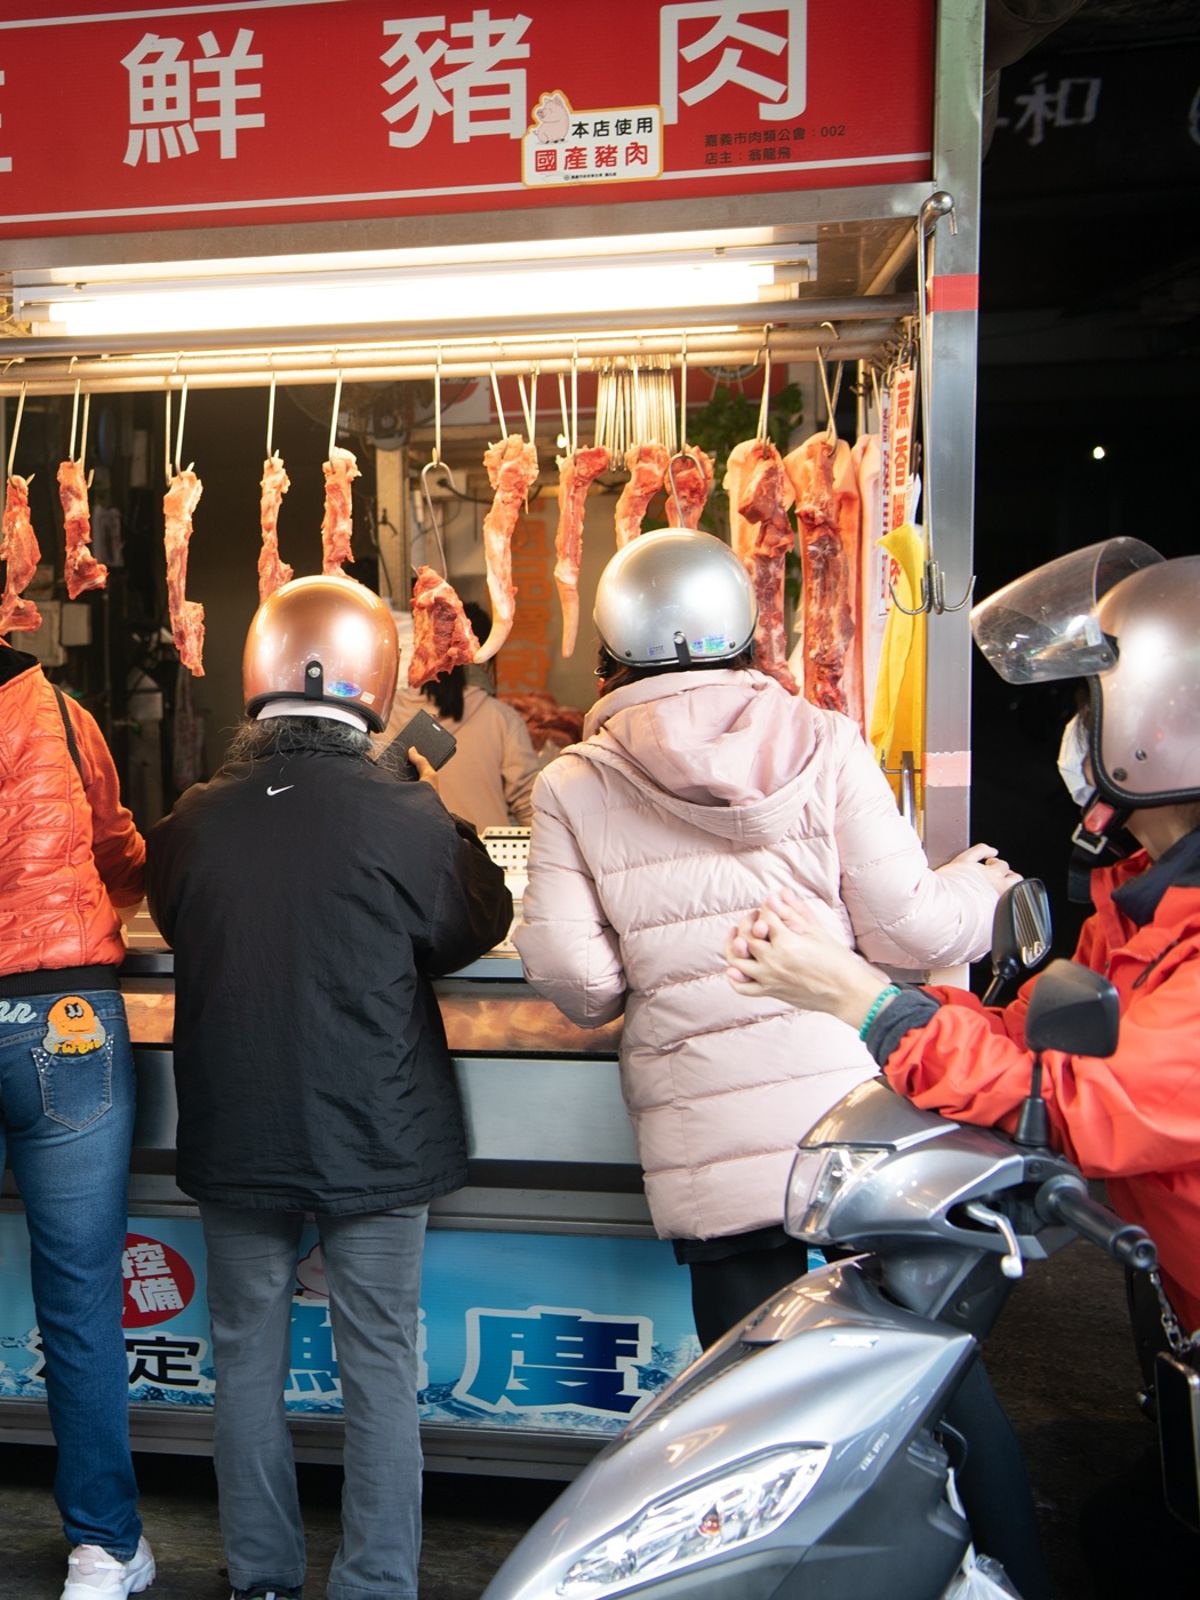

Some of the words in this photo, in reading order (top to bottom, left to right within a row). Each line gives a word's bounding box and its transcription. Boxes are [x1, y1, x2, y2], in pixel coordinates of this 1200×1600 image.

[997, 71, 1103, 147] 和
[571, 117, 654, 139] 本店使用
[534, 141, 648, 173] 國產豬肉
[121, 1242, 173, 1279] 控
[121, 1276, 186, 1314] 備
